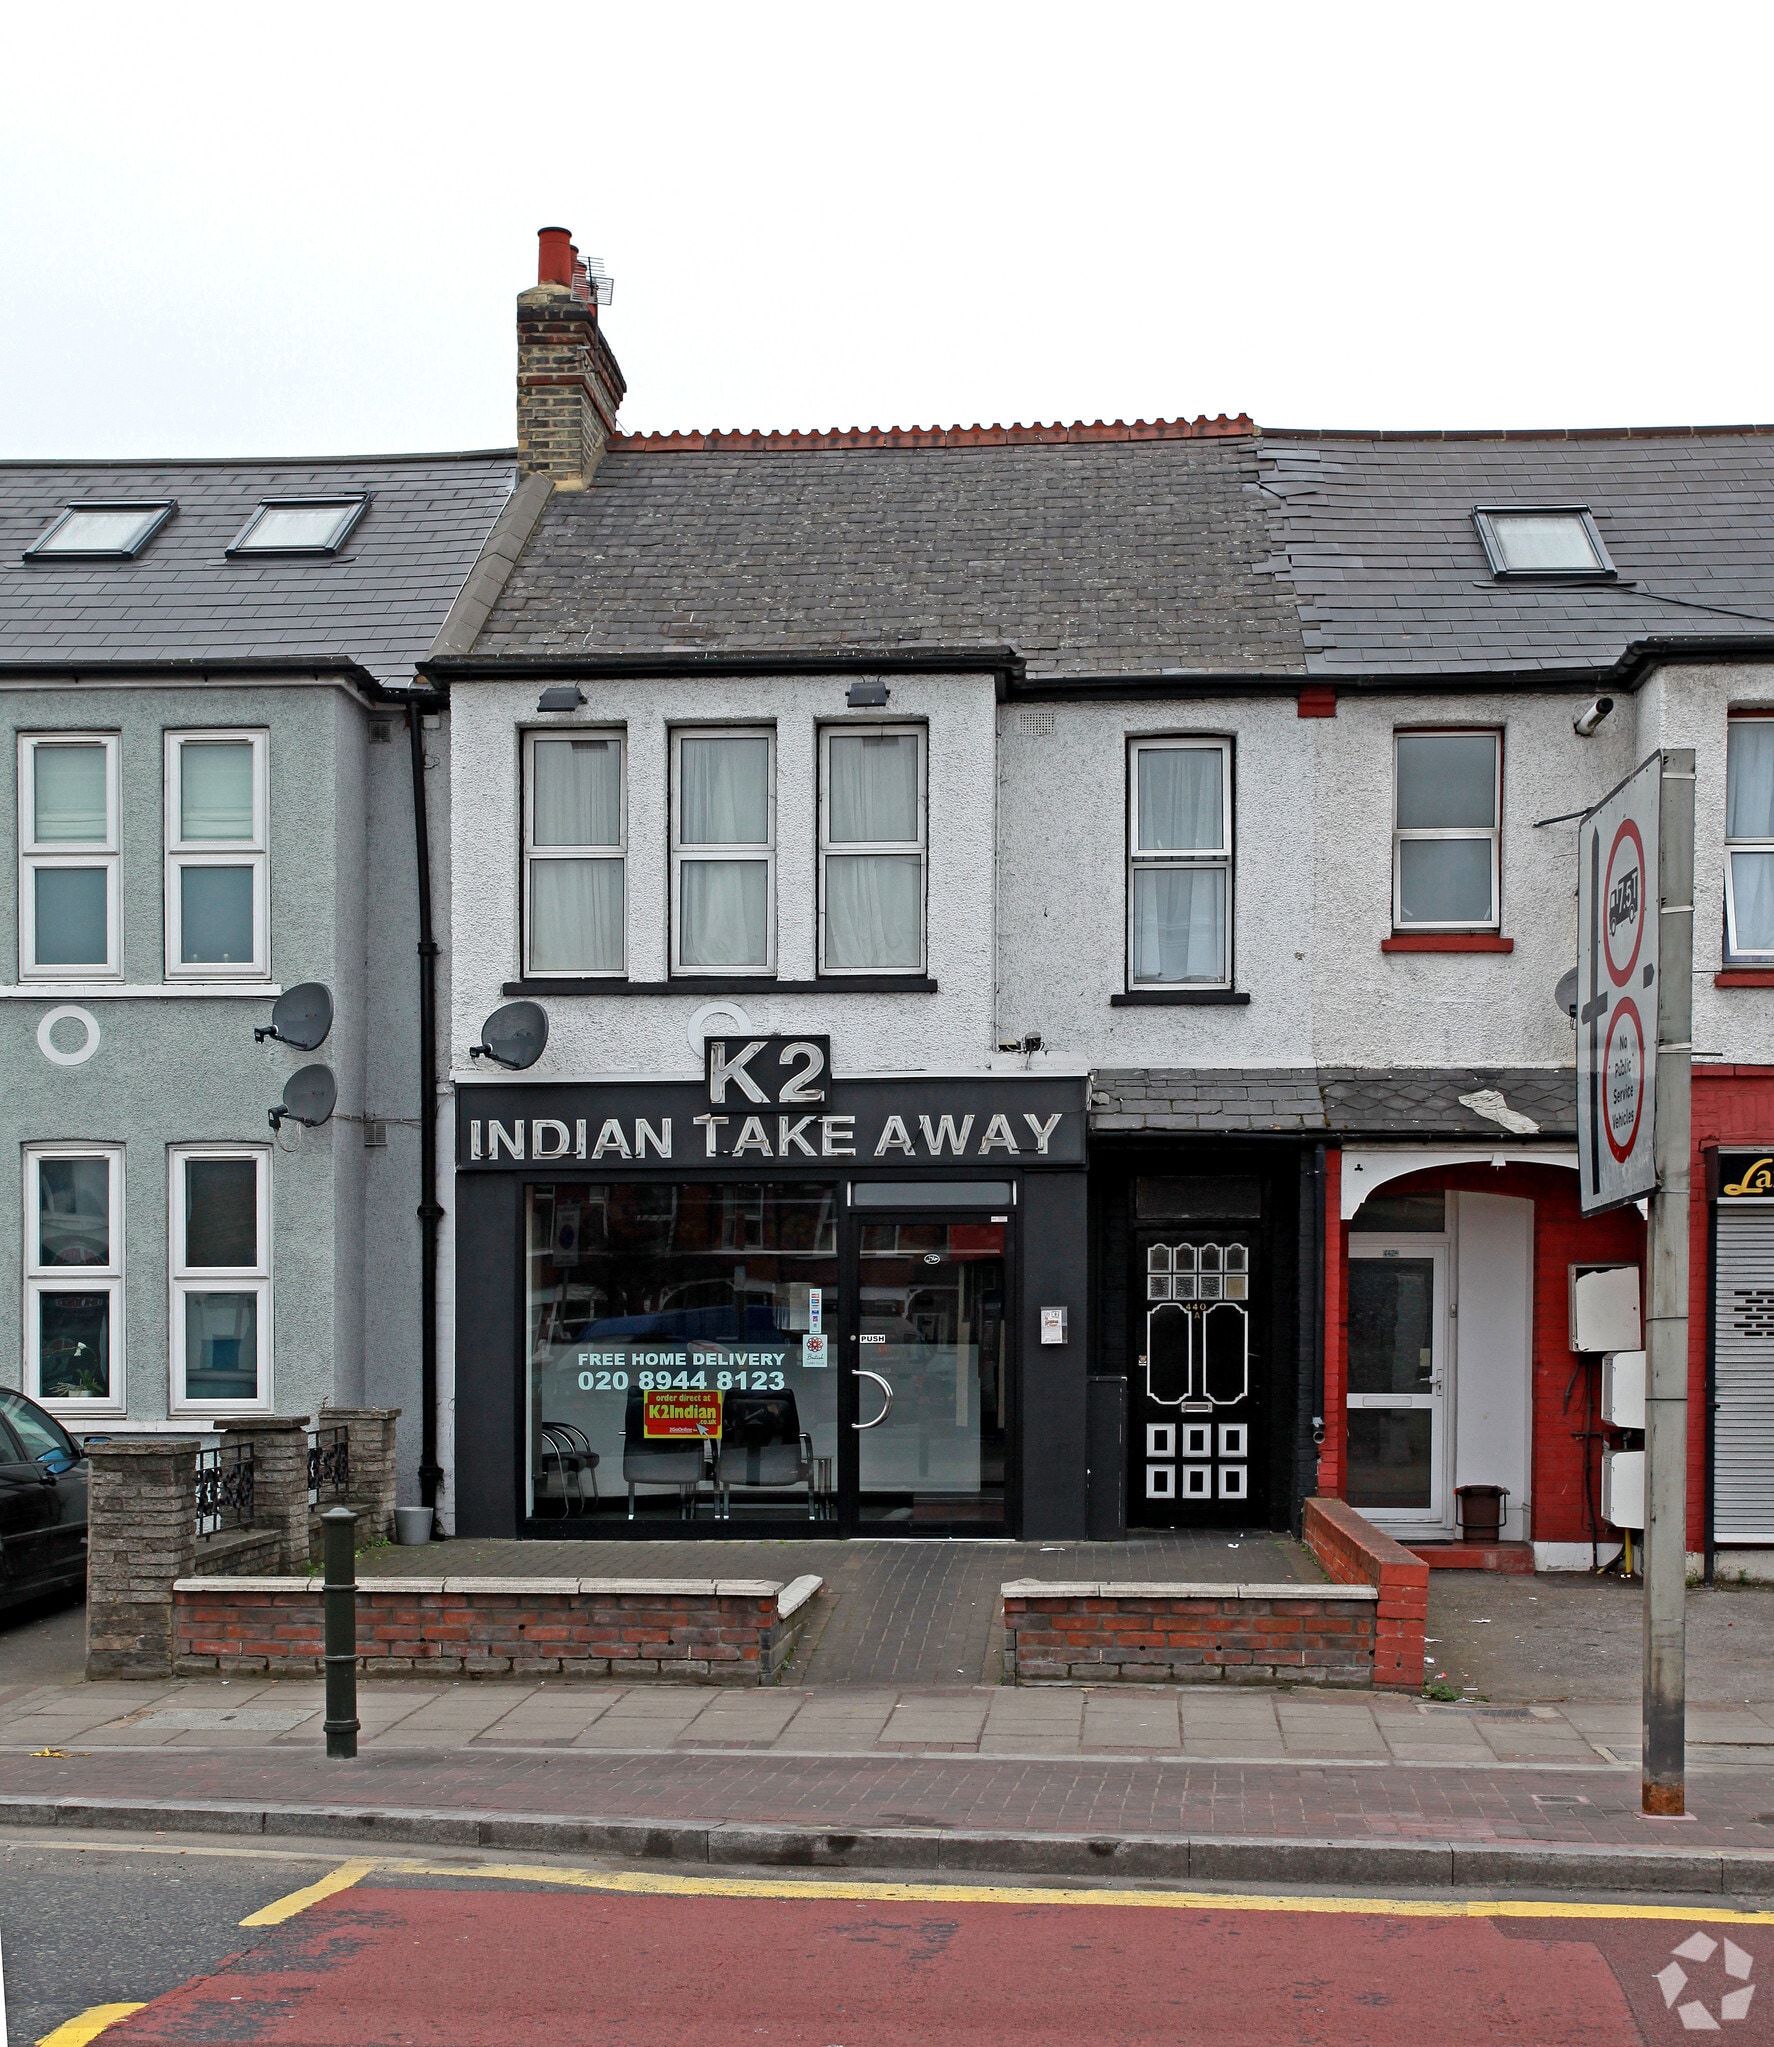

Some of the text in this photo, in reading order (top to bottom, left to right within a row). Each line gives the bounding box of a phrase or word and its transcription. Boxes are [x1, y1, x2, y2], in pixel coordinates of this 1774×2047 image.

[1618, 871, 1637, 913] 7.5T
[1619, 1035, 1628, 1050] No
[710, 1041, 825, 1104] K2
[1614, 1059, 1632, 1079] Public
[1613, 1084, 1634, 1104] Service
[1611, 1110, 1635, 1130] Vehicles
[470, 1112, 1062, 1160] INDIAN TAKE AWAY
[1723, 1158, 1774, 1196] La
[1185, 1303, 1207, 1311] 440
[578, 1353, 786, 1366] FREE HOME DELIVERY
[578, 1371, 786, 1391] 020 8944 8123
[655, 1394, 677, 1402] order
[679, 1394, 701, 1402] direct
[648, 1404, 717, 1419] K2Indian
